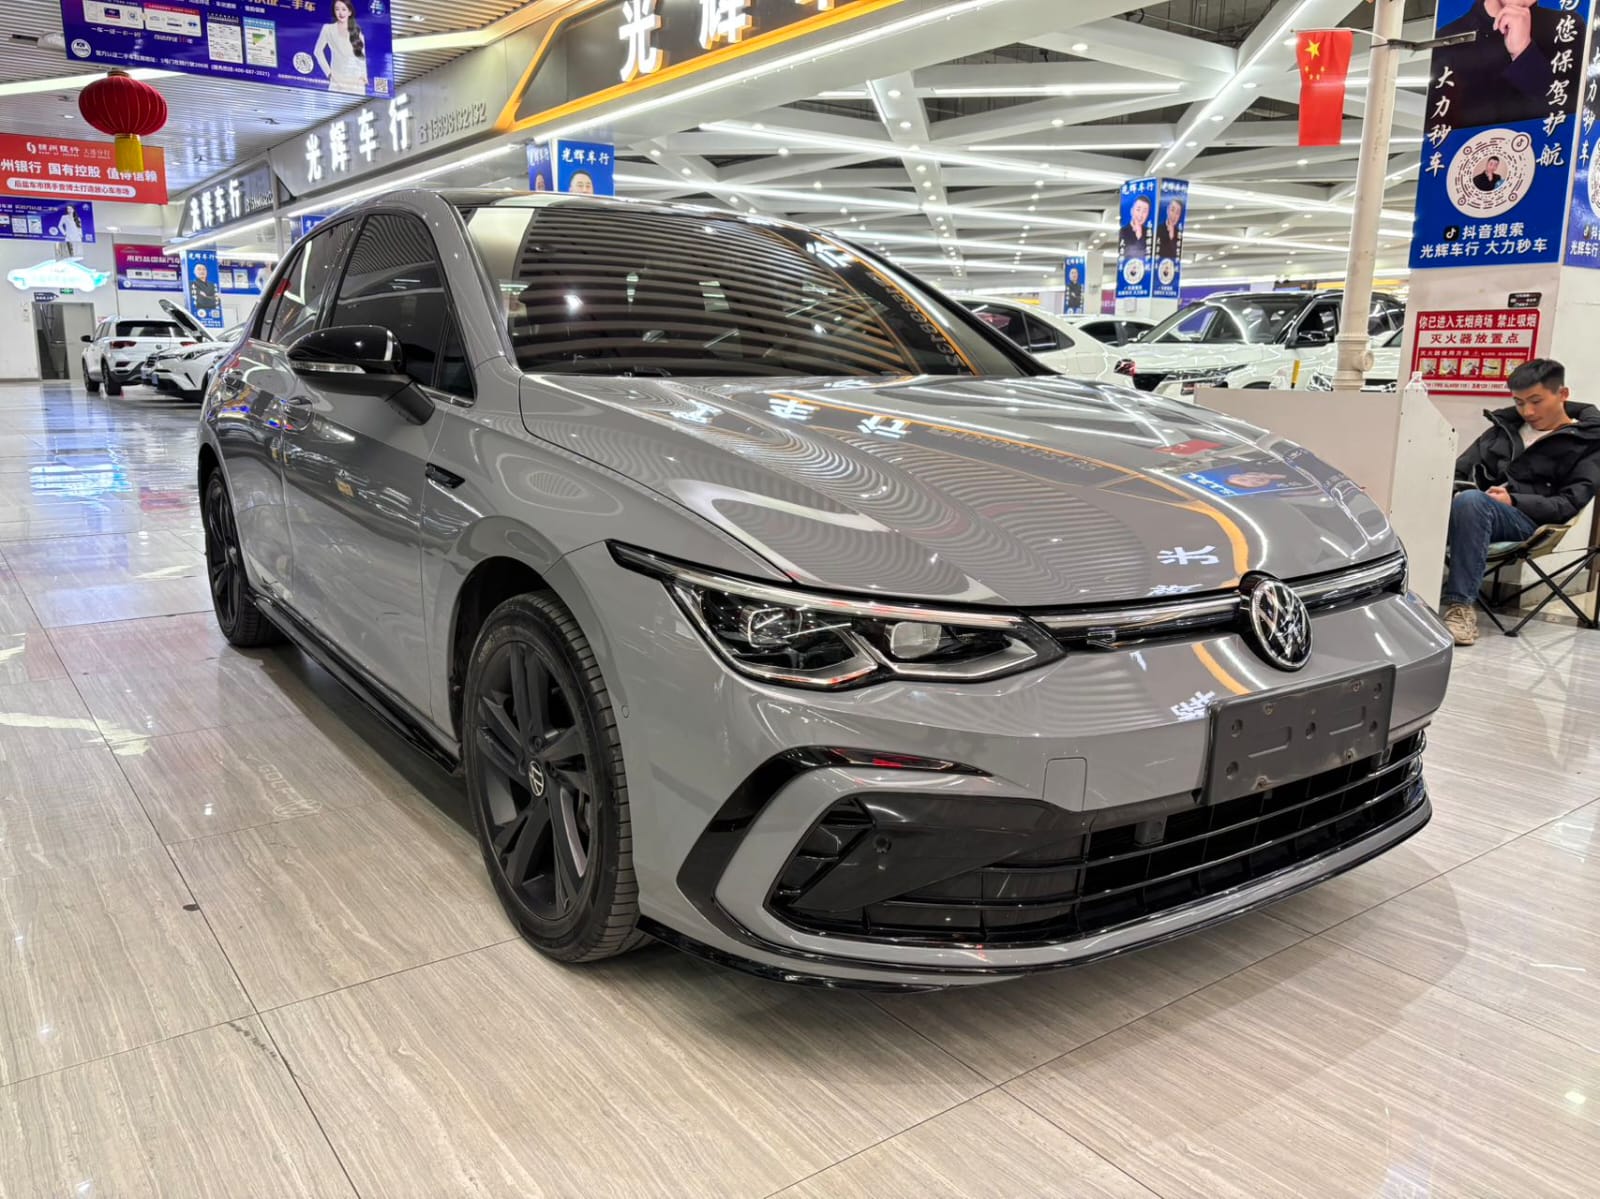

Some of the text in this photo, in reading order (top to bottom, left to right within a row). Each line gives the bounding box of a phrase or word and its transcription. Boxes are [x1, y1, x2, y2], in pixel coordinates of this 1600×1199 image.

[1425, 66, 1456, 176] 大力秒车
[305, 93, 411, 184] 光辉车行
[562, 147, 610, 165] 光辉车行
[48, 163, 101, 178] 国有控股
[190, 179, 240, 232] 光辉车行
[1462, 222, 1525, 240] 抖音搜索
[1420, 238, 1548, 259] 光辉车行 大力秒车
[1419, 313, 1537, 329] 你已进入无烟商场 禁止吸烟
[1430, 333, 1519, 345] 灭火器放置点
